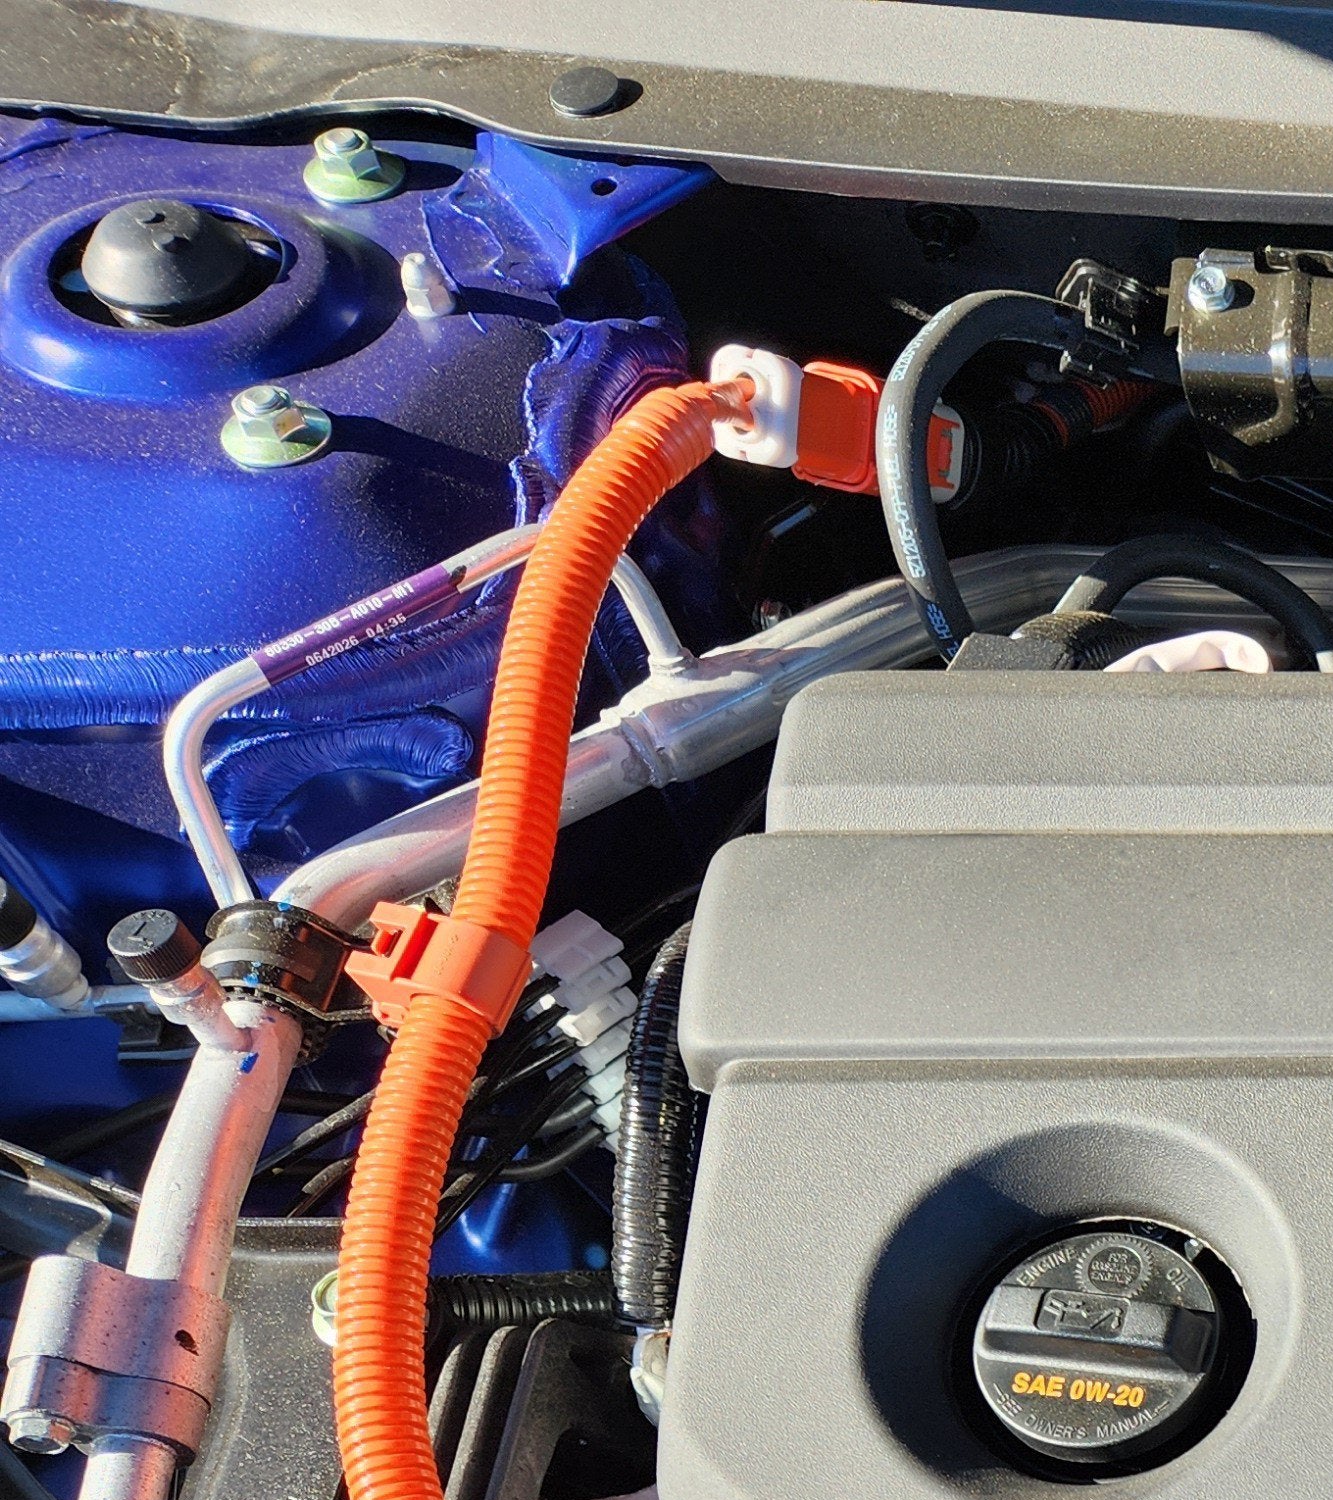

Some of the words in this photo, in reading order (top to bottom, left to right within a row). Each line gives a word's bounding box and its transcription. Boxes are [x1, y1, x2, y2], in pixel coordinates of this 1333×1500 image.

[1016, 1247, 1081, 1287] ENGINE
[1165, 1266, 1192, 1293] OIL
[1011, 1371, 1066, 1398] SAE
[1069, 1378, 1146, 1408] 0W-20
[1023, 1413, 1088, 1439] OWNER'S
